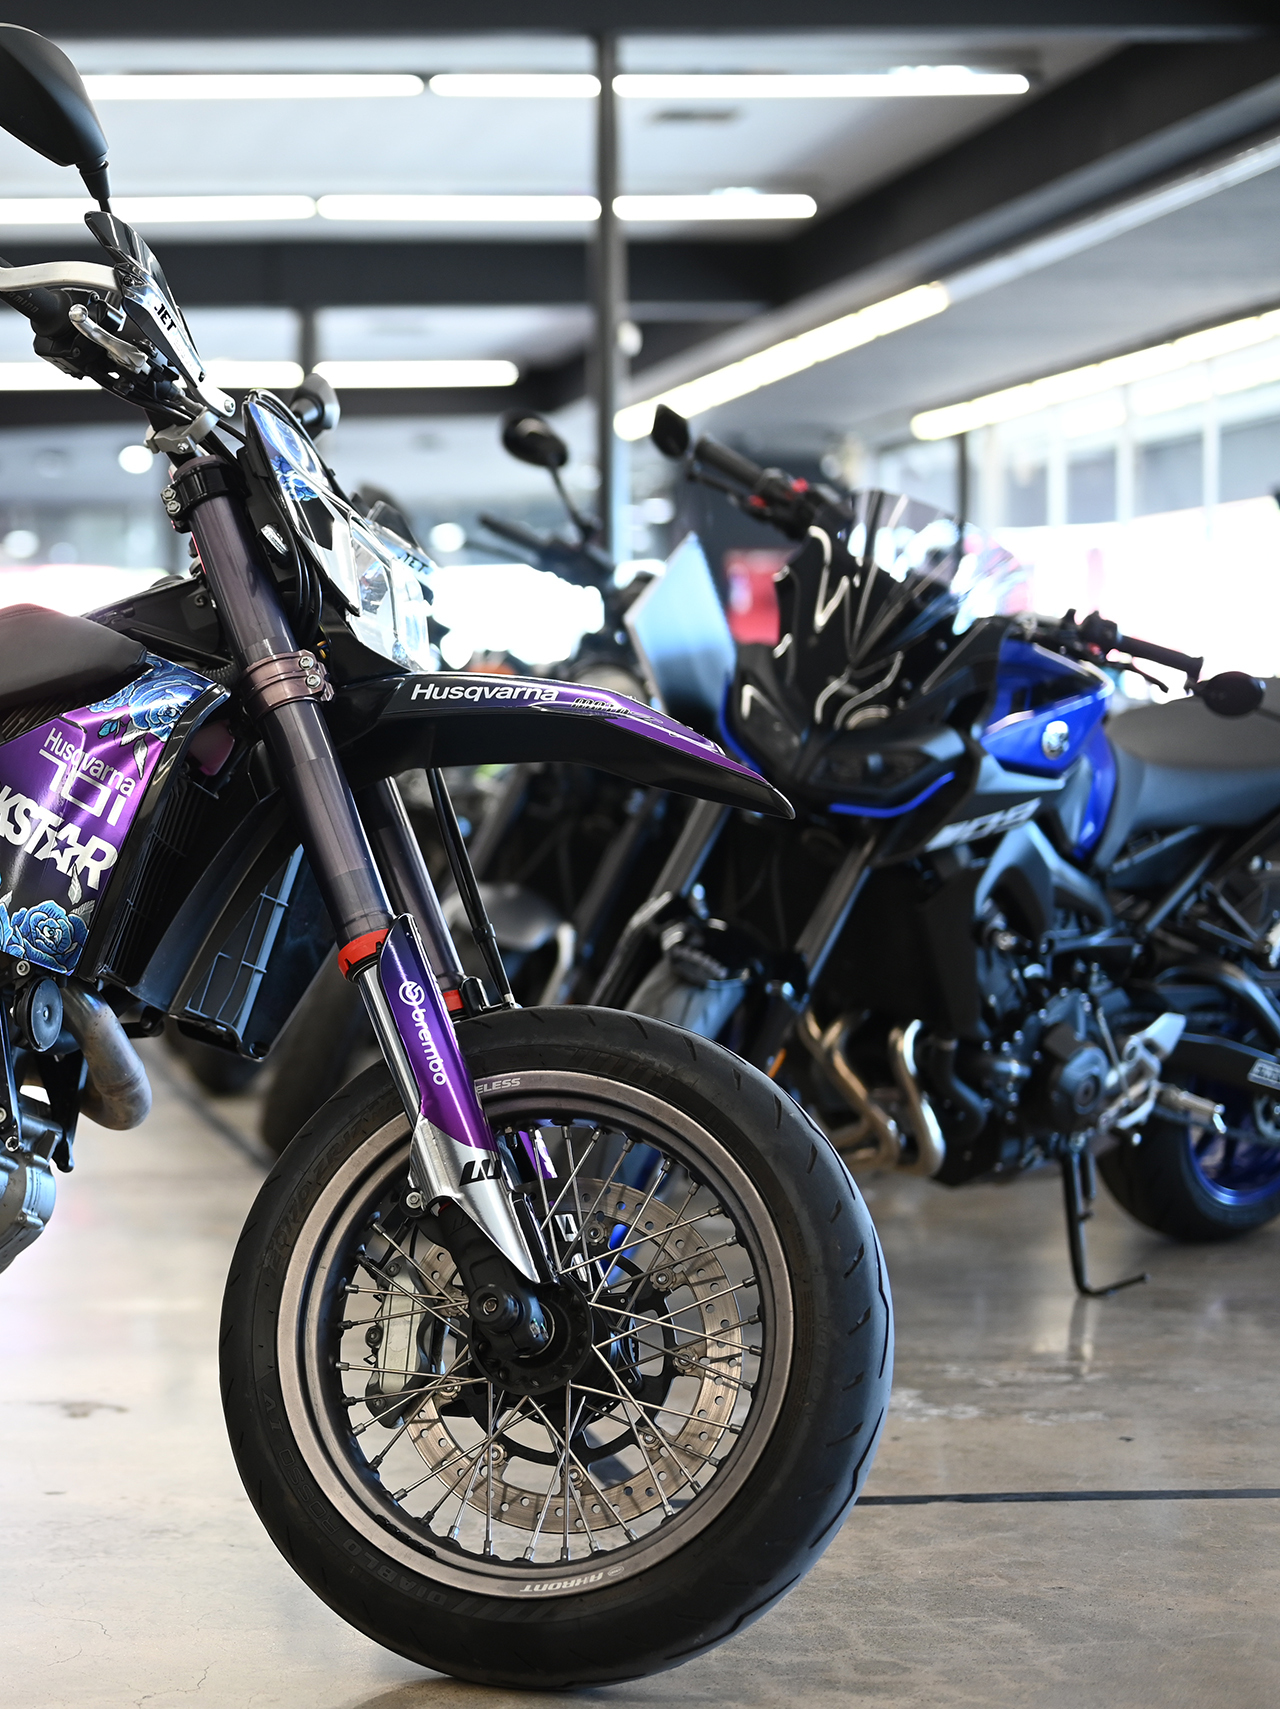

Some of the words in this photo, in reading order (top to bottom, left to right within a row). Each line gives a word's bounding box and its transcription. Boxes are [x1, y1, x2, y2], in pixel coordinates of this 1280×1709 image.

[154, 303, 177, 332] JET
[411, 683, 559, 702] Husqvarna
[43, 727, 136, 798] Husqvarna
[411, 1008, 447, 1086] brembo
[476, 1077, 521, 1095] ELESS
[278, 1447, 342, 1536] ROSSO
[342, 1538, 449, 1604] DIABLO
